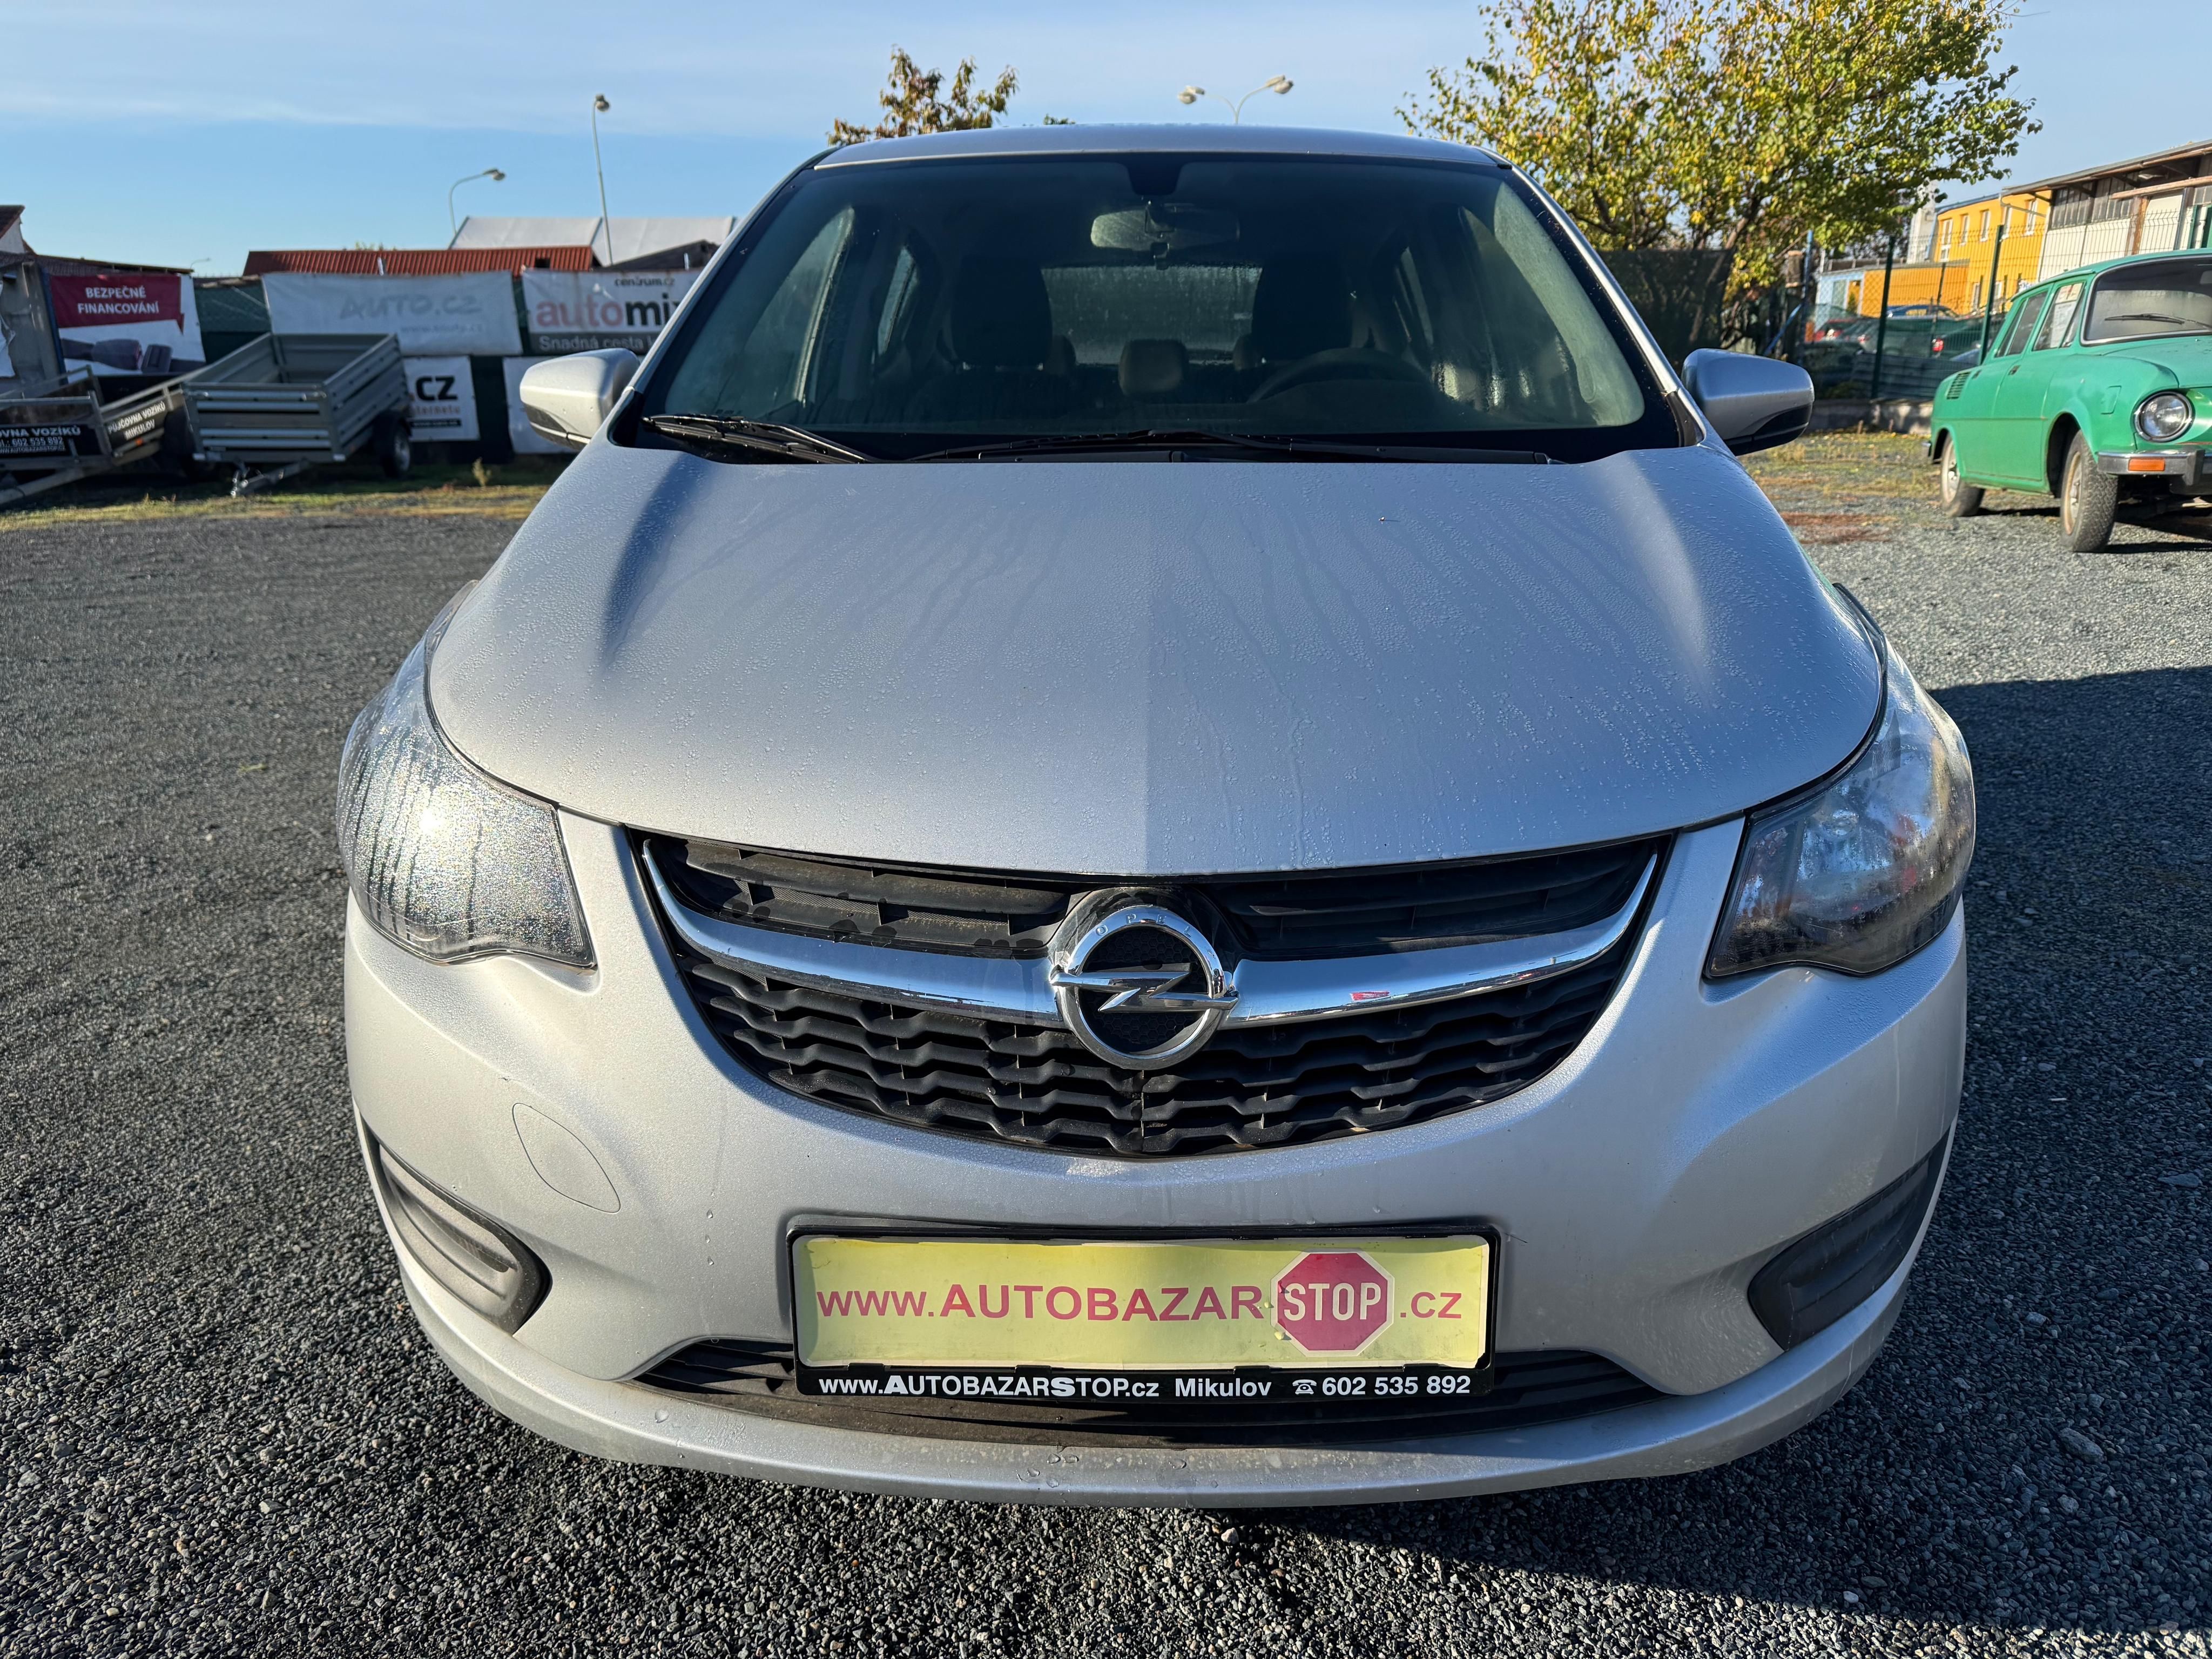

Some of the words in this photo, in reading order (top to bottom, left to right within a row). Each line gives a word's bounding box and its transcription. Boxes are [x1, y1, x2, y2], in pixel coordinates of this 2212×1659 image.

[85, 285, 146, 298] BEZPEČNÉ
[77, 301, 159, 314] FINANCOVÁNÍ
[536, 292, 679, 327] automi
[540, 336, 599, 350] Snadná
[602, 337, 644, 349] cesta
[124, 419, 155, 440] MIKULOV
[12, 438, 28, 447] 602
[1096, 914, 1191, 938] OPEL
[1284, 1282, 1381, 1321] STOP
[1175, 1378, 1272, 1397] Mikulov
[1322, 1377, 1366, 1395] 602
[1374, 1377, 1418, 1394] 535
[1426, 1375, 1470, 1394] 892
